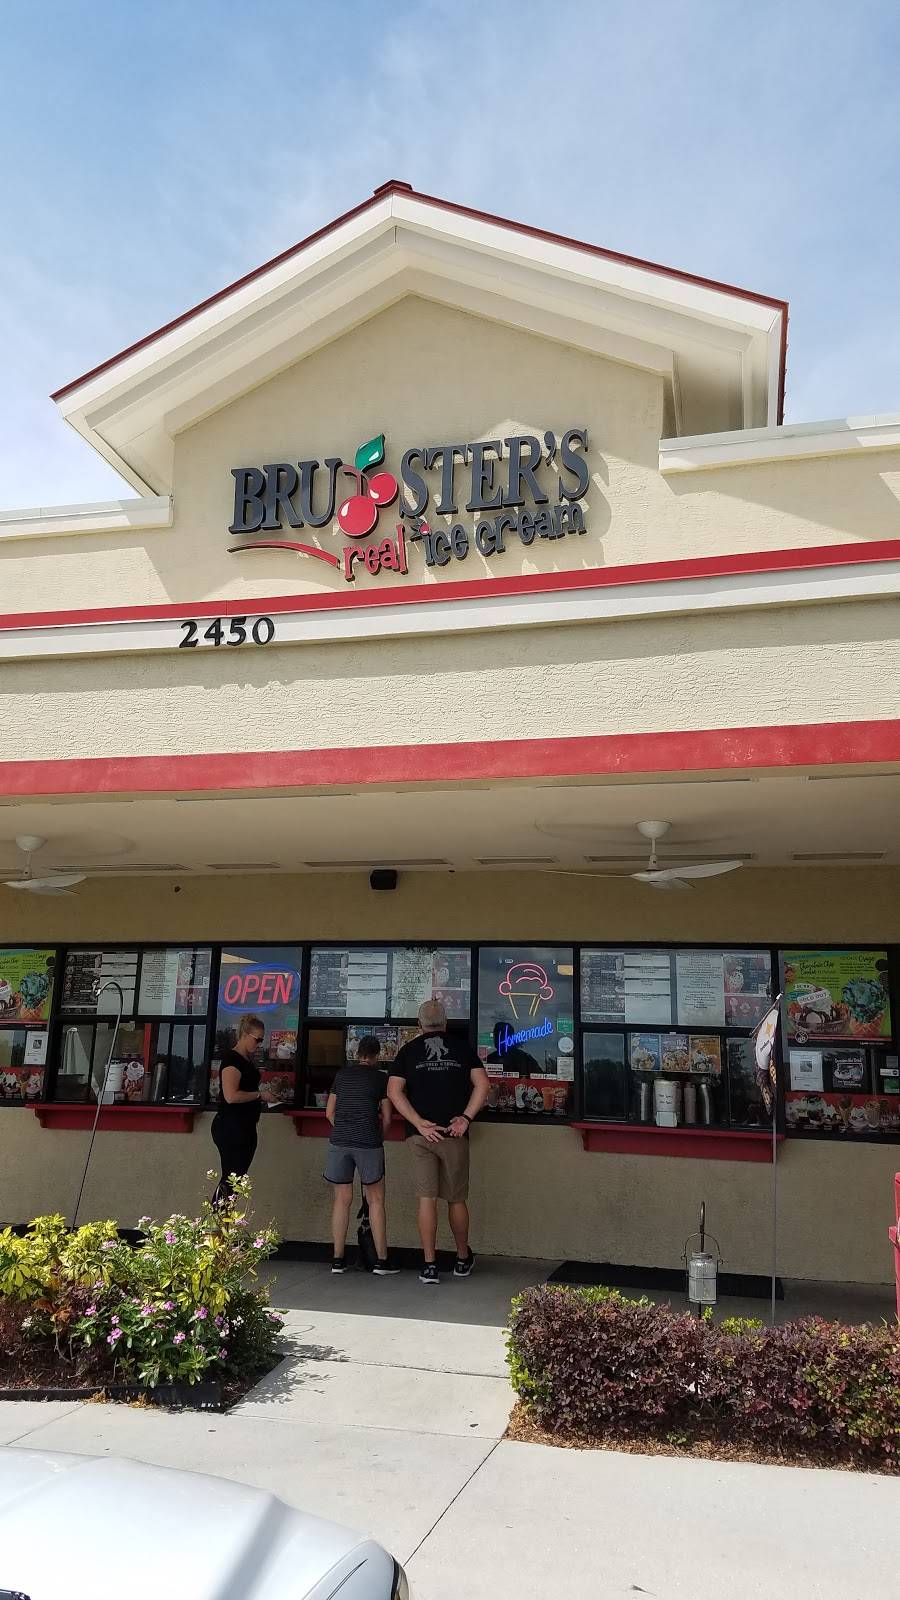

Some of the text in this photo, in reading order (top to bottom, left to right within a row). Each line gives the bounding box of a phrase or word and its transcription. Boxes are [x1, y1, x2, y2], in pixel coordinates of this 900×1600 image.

[342, 503, 588, 582] real ice cream
[179, 615, 276, 648] 2450
[223, 973, 294, 1005] OPEN
[497, 1016, 554, 1057] Homemade
